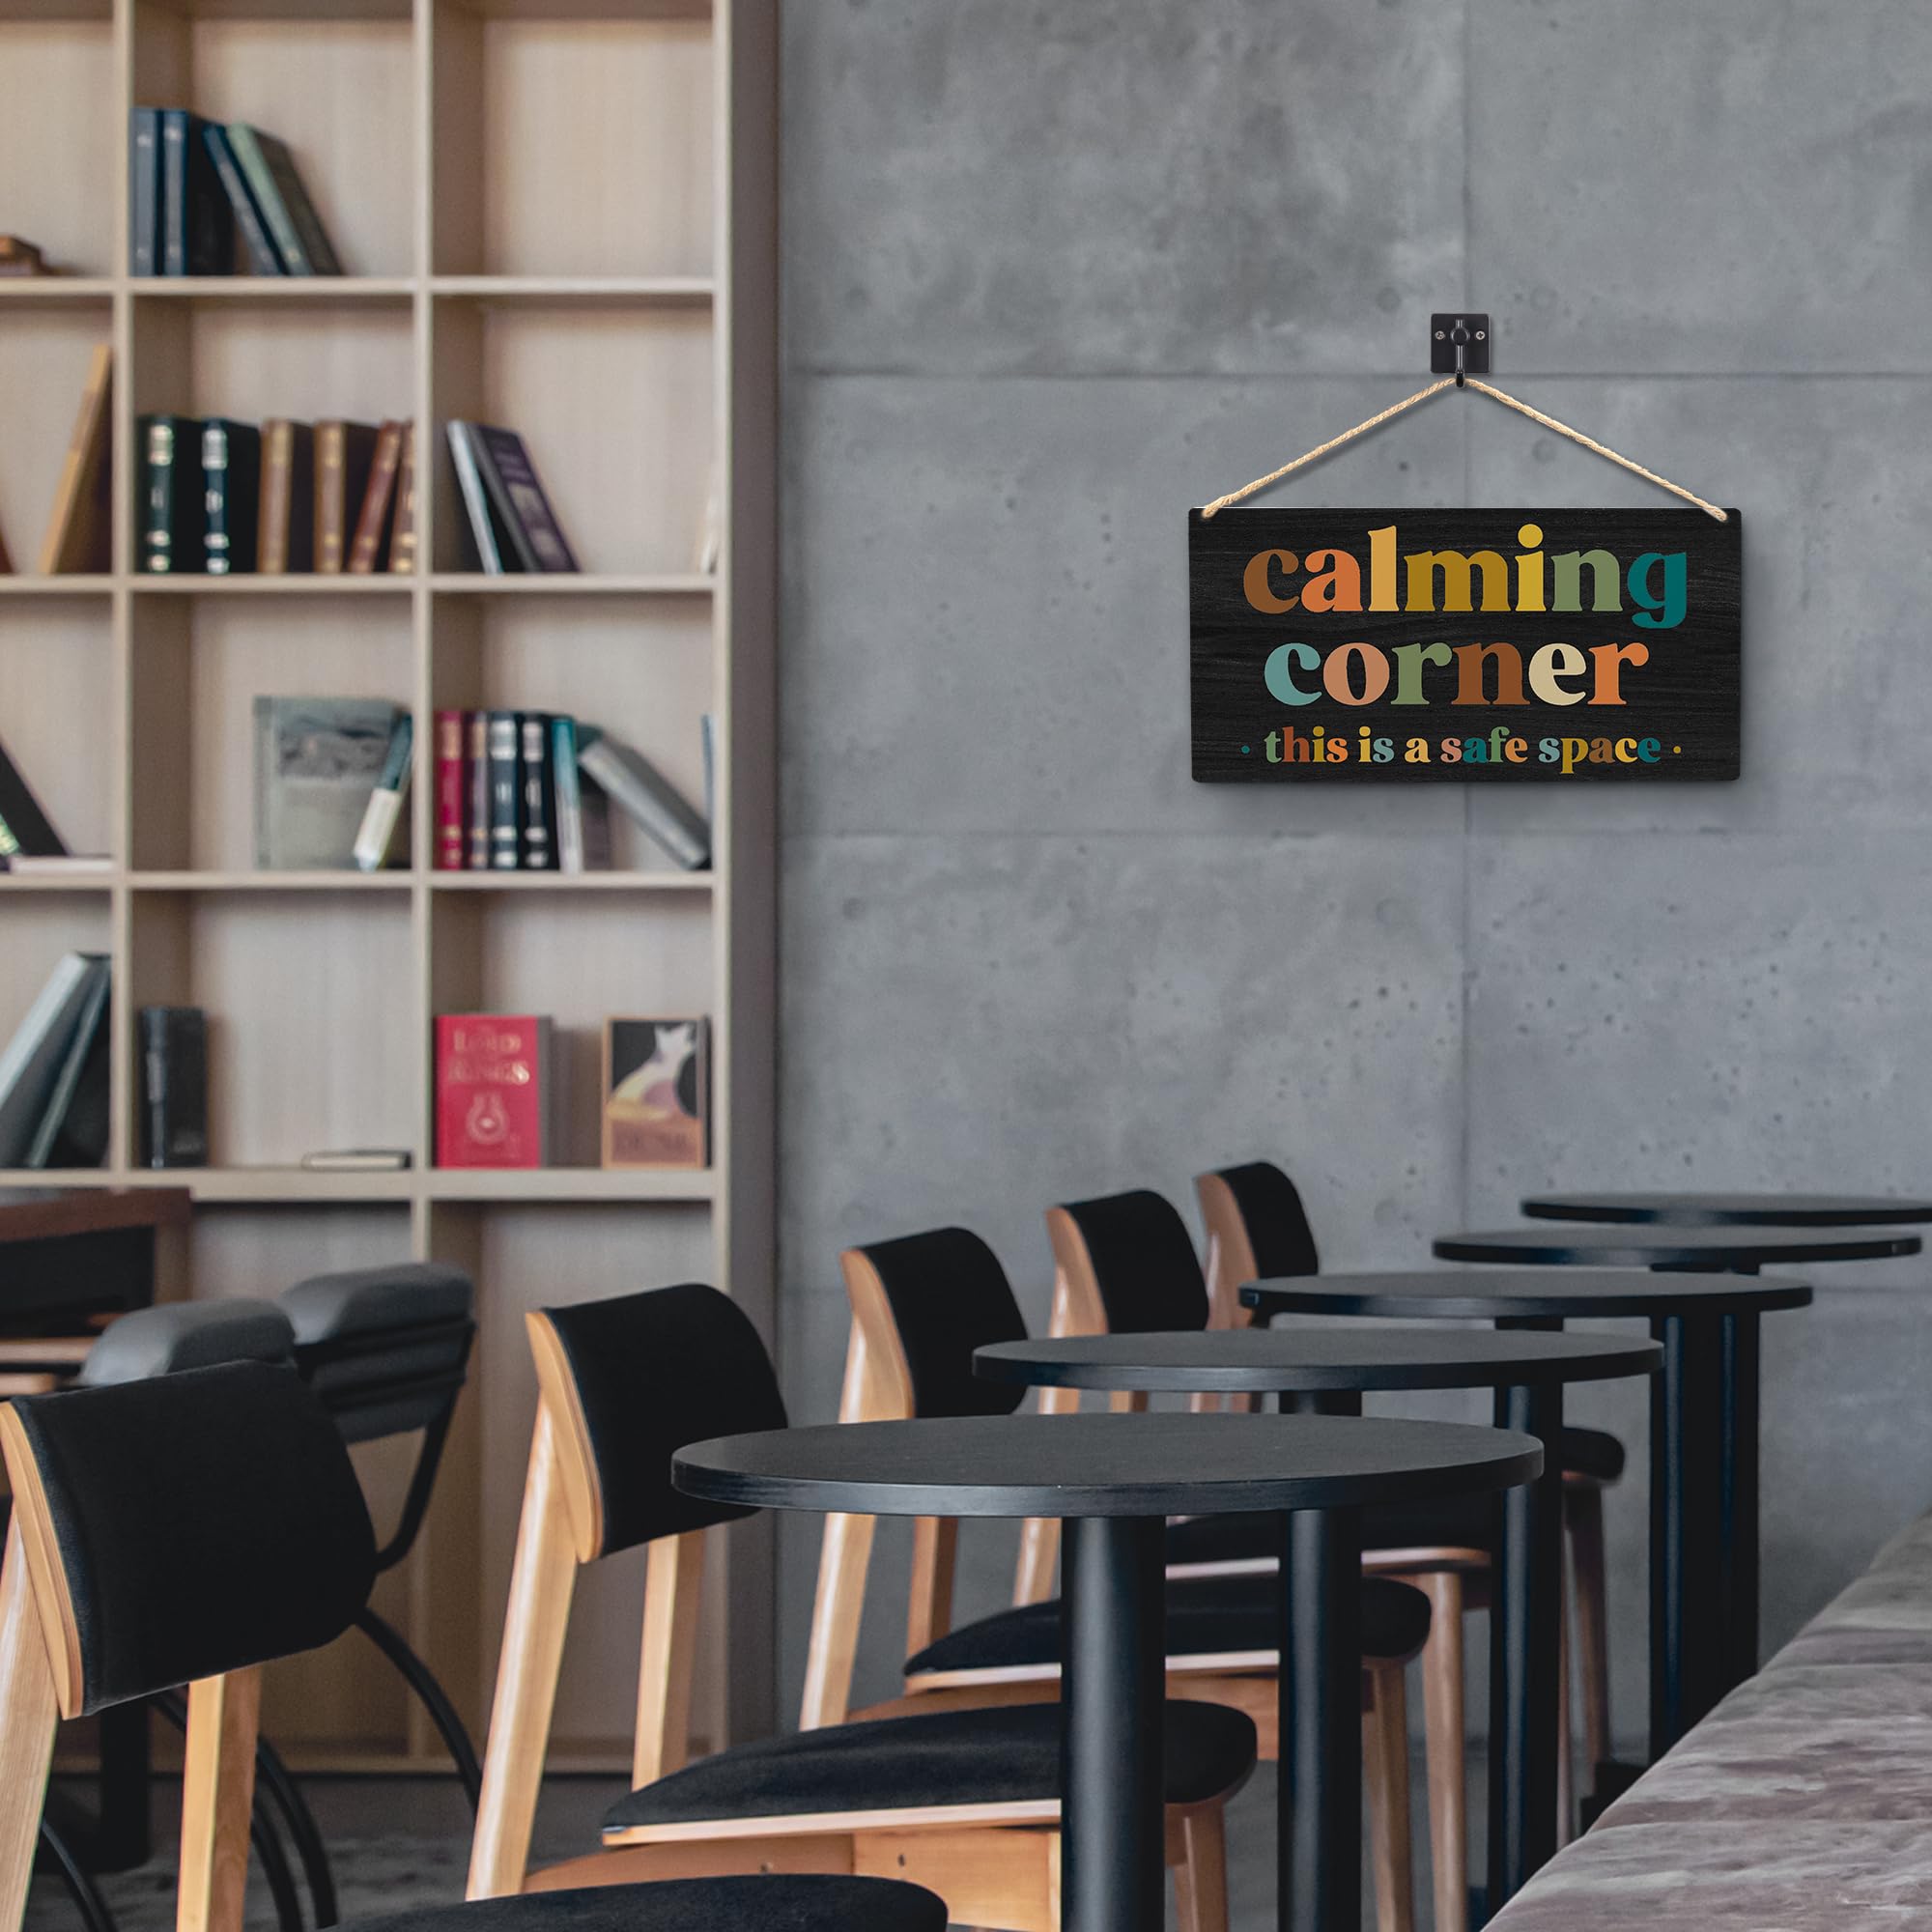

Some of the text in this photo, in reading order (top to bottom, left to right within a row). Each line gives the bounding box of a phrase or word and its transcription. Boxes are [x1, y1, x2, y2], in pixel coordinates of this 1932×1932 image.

[1243, 524, 1687, 629] calming
[1264, 642, 1649, 705] corner
[1264, 726, 1661, 774] this is a safe space
